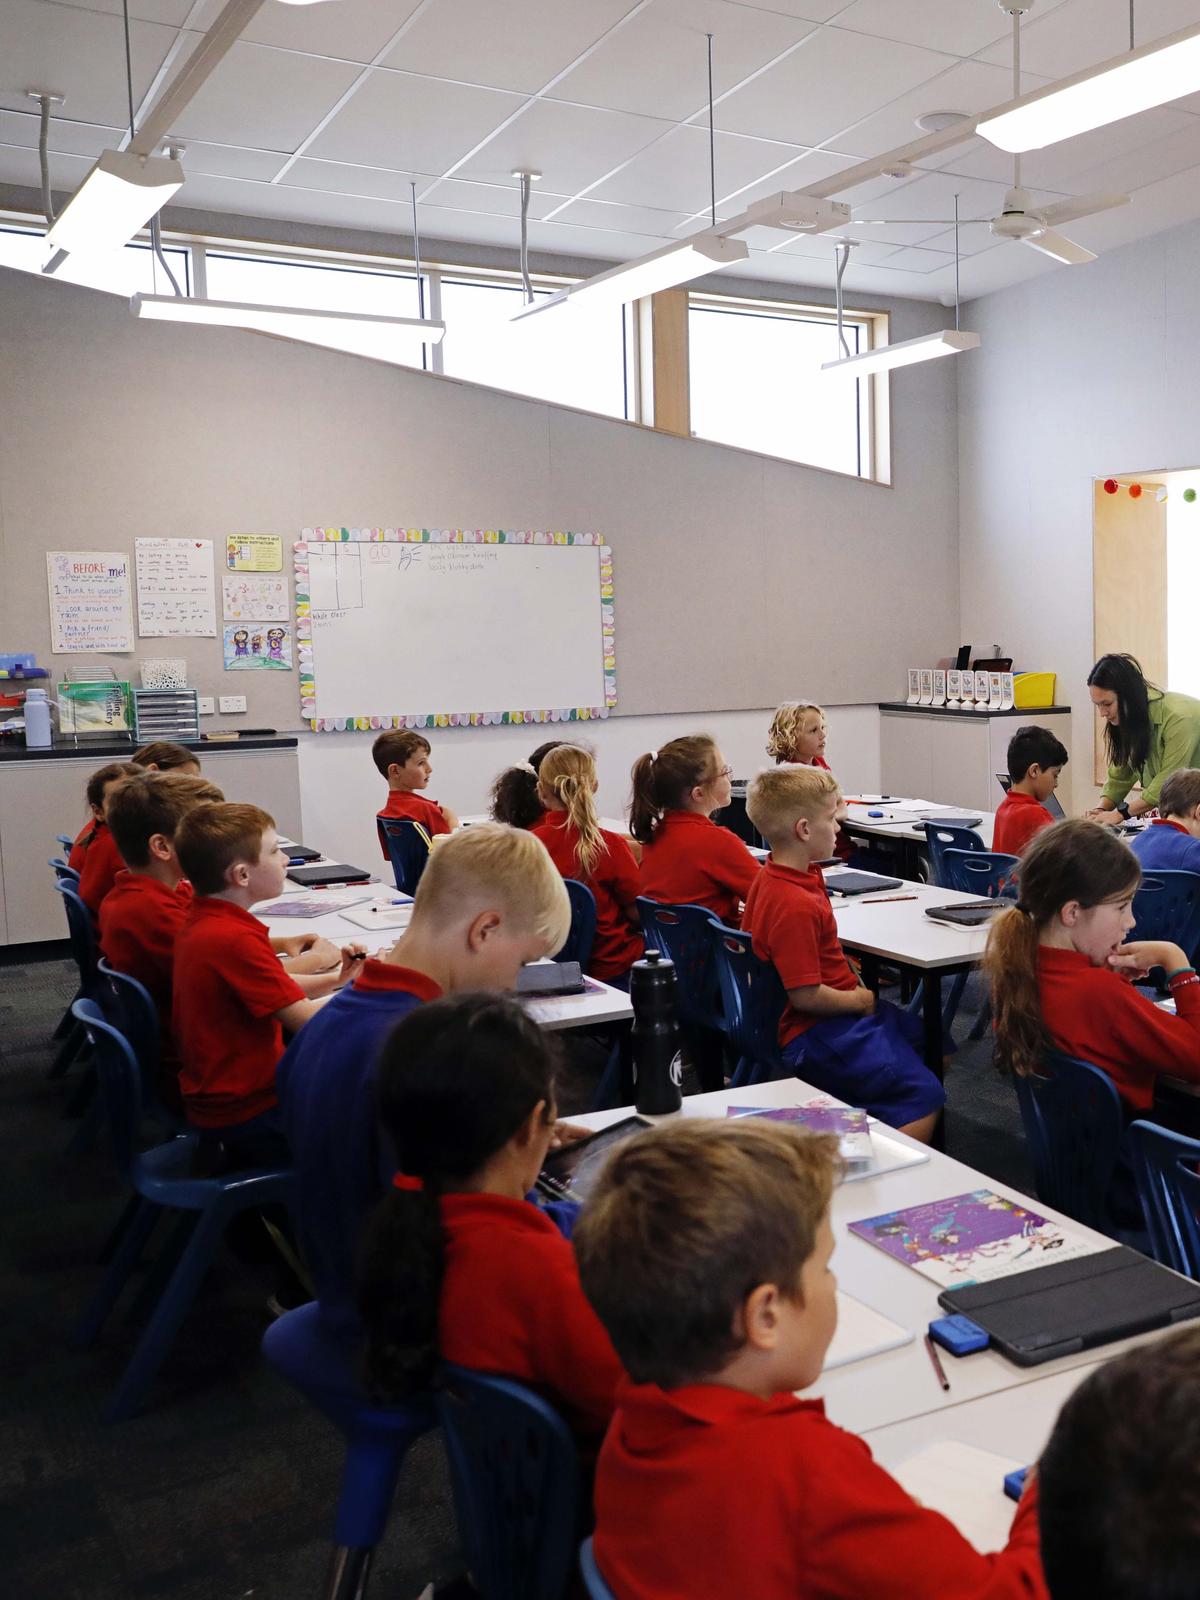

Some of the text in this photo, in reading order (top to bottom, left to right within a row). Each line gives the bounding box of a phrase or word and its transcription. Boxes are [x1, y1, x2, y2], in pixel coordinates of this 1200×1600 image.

[73, 562, 105, 573] BEFORE
[108, 563, 126, 578] me!
[112, 685, 122, 716] Spelling
